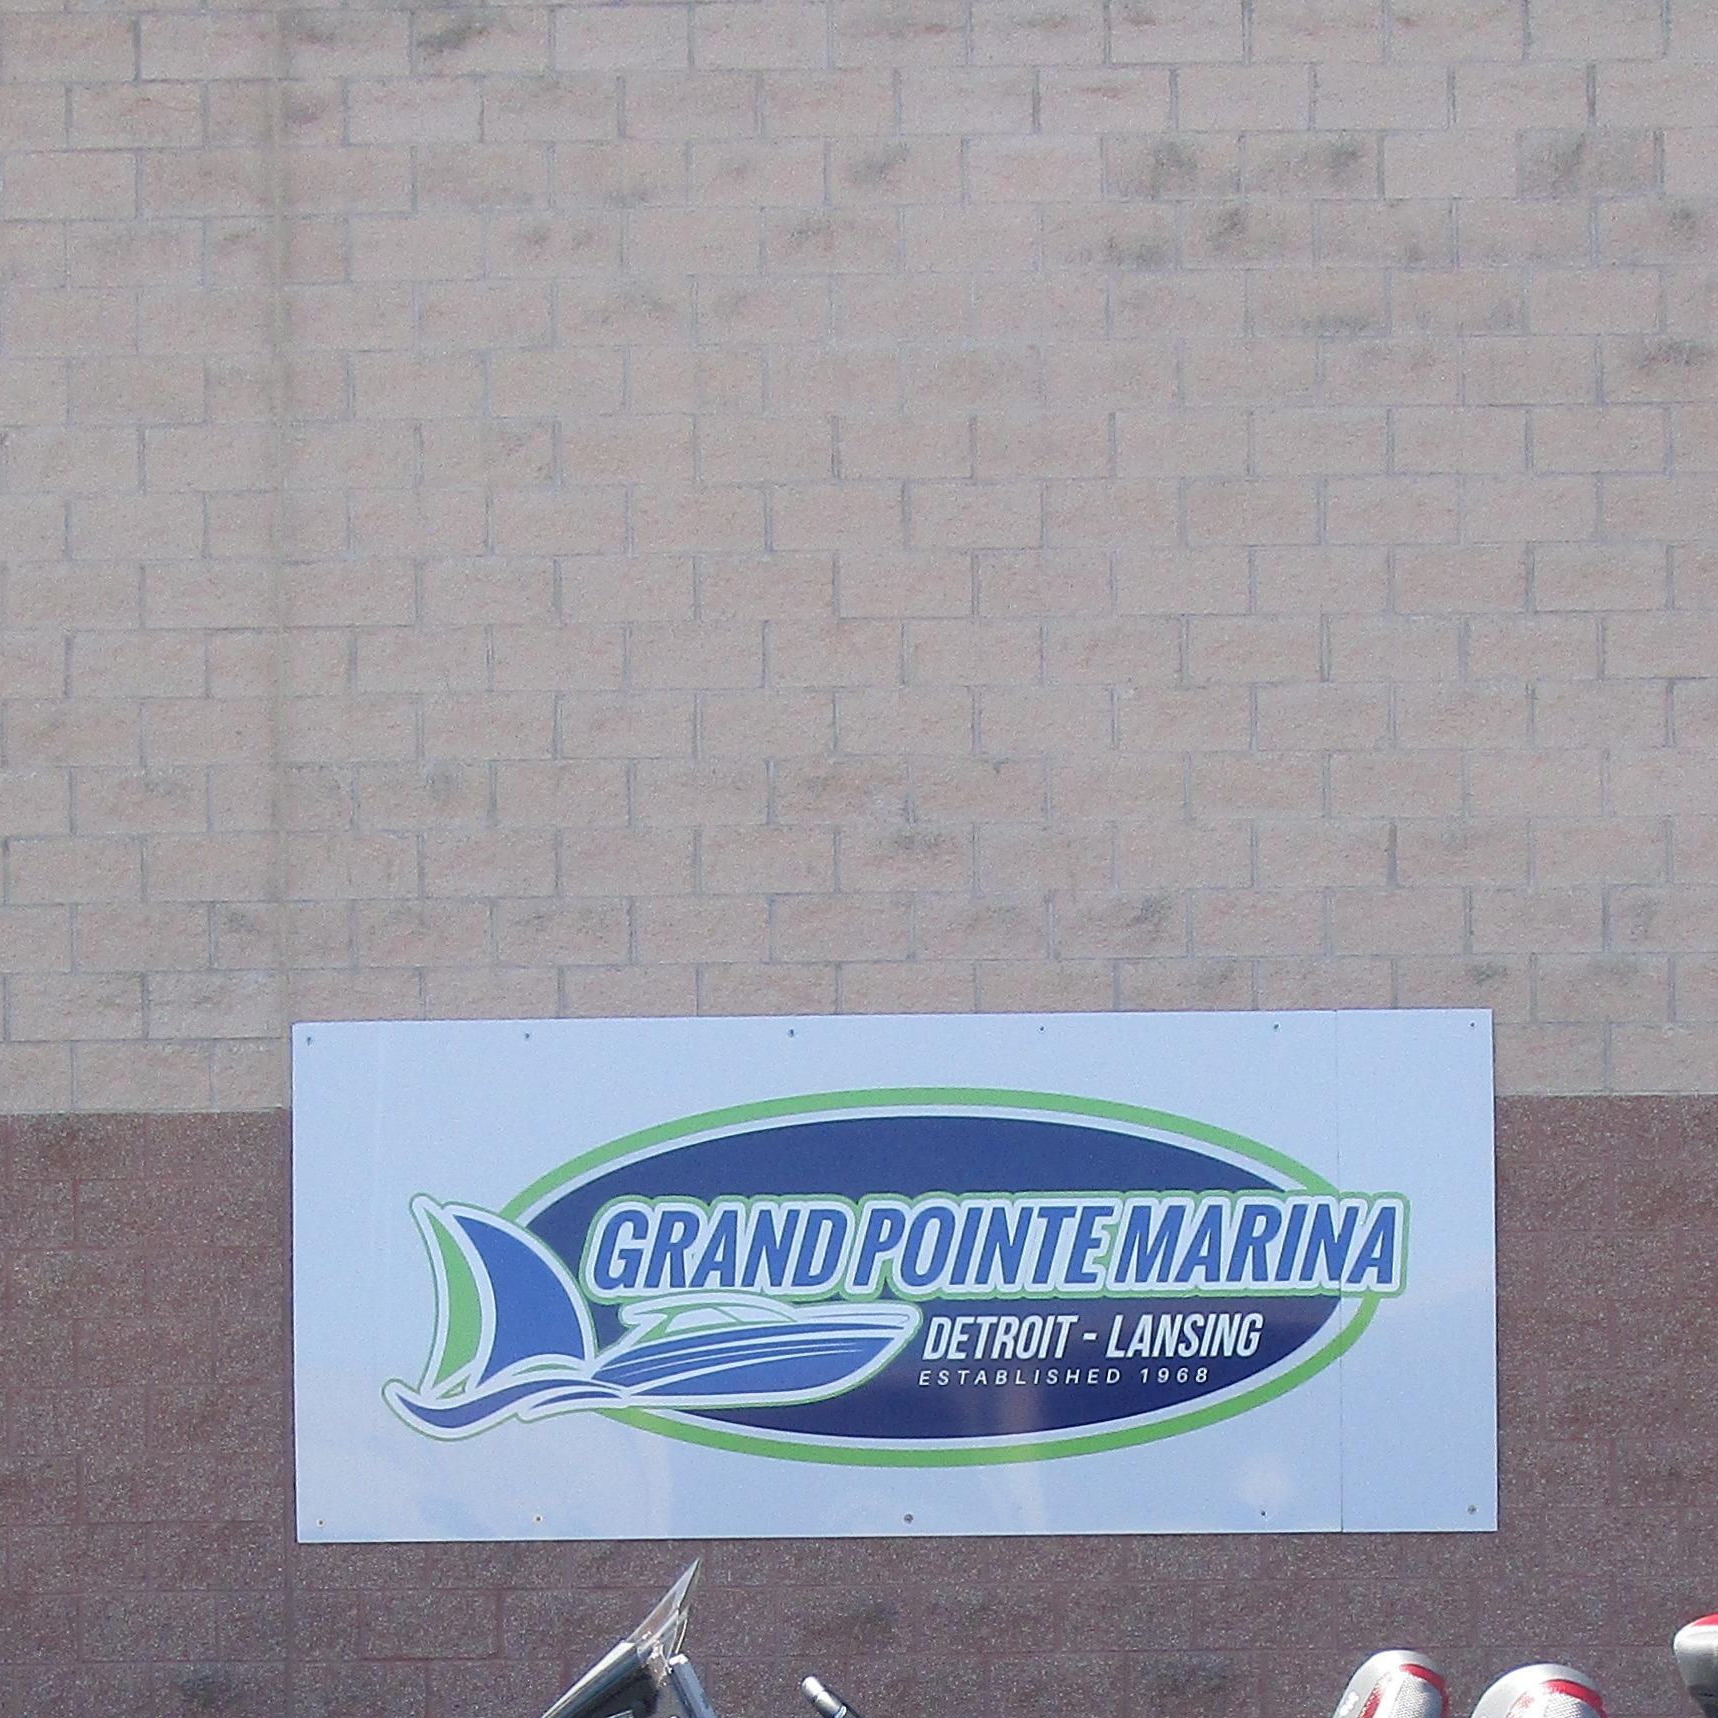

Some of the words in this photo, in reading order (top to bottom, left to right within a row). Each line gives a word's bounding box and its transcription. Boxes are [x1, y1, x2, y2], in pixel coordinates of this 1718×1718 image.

[592, 1207, 849, 1291] GRAND
[851, 1205, 1115, 1289] POINTE
[1113, 1202, 1397, 1286] MARINA
[921, 1314, 1080, 1362] DETROIT
[1104, 1312, 1265, 1359] LANSING
[917, 1368, 1122, 1387] ESTABLISHED
[1139, 1367, 1209, 1385] 1968
